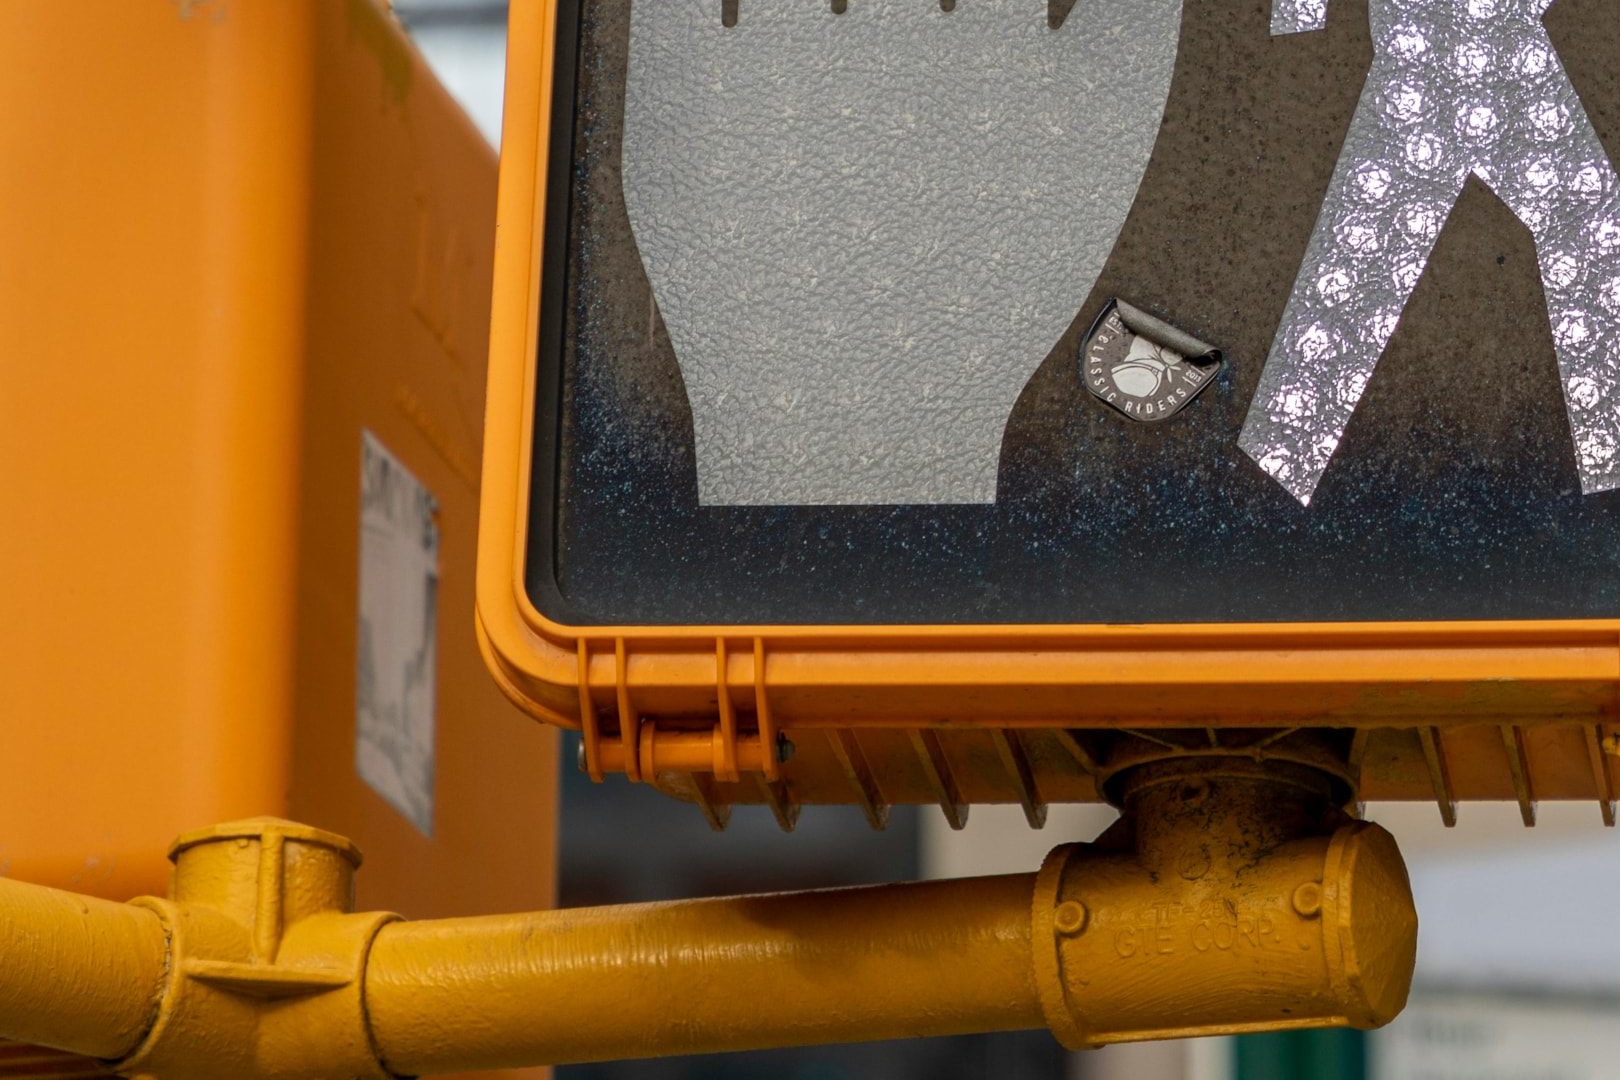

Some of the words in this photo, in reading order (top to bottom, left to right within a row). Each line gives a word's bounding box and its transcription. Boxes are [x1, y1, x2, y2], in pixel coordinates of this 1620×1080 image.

[1090, 334, 1117, 403] CLASSIC
[1124, 389, 1187, 414] RIDERS
[1185, 369, 1202, 383] 2013
[1114, 924, 1174, 959] GTE
[1190, 919, 1281, 953] CORP.
